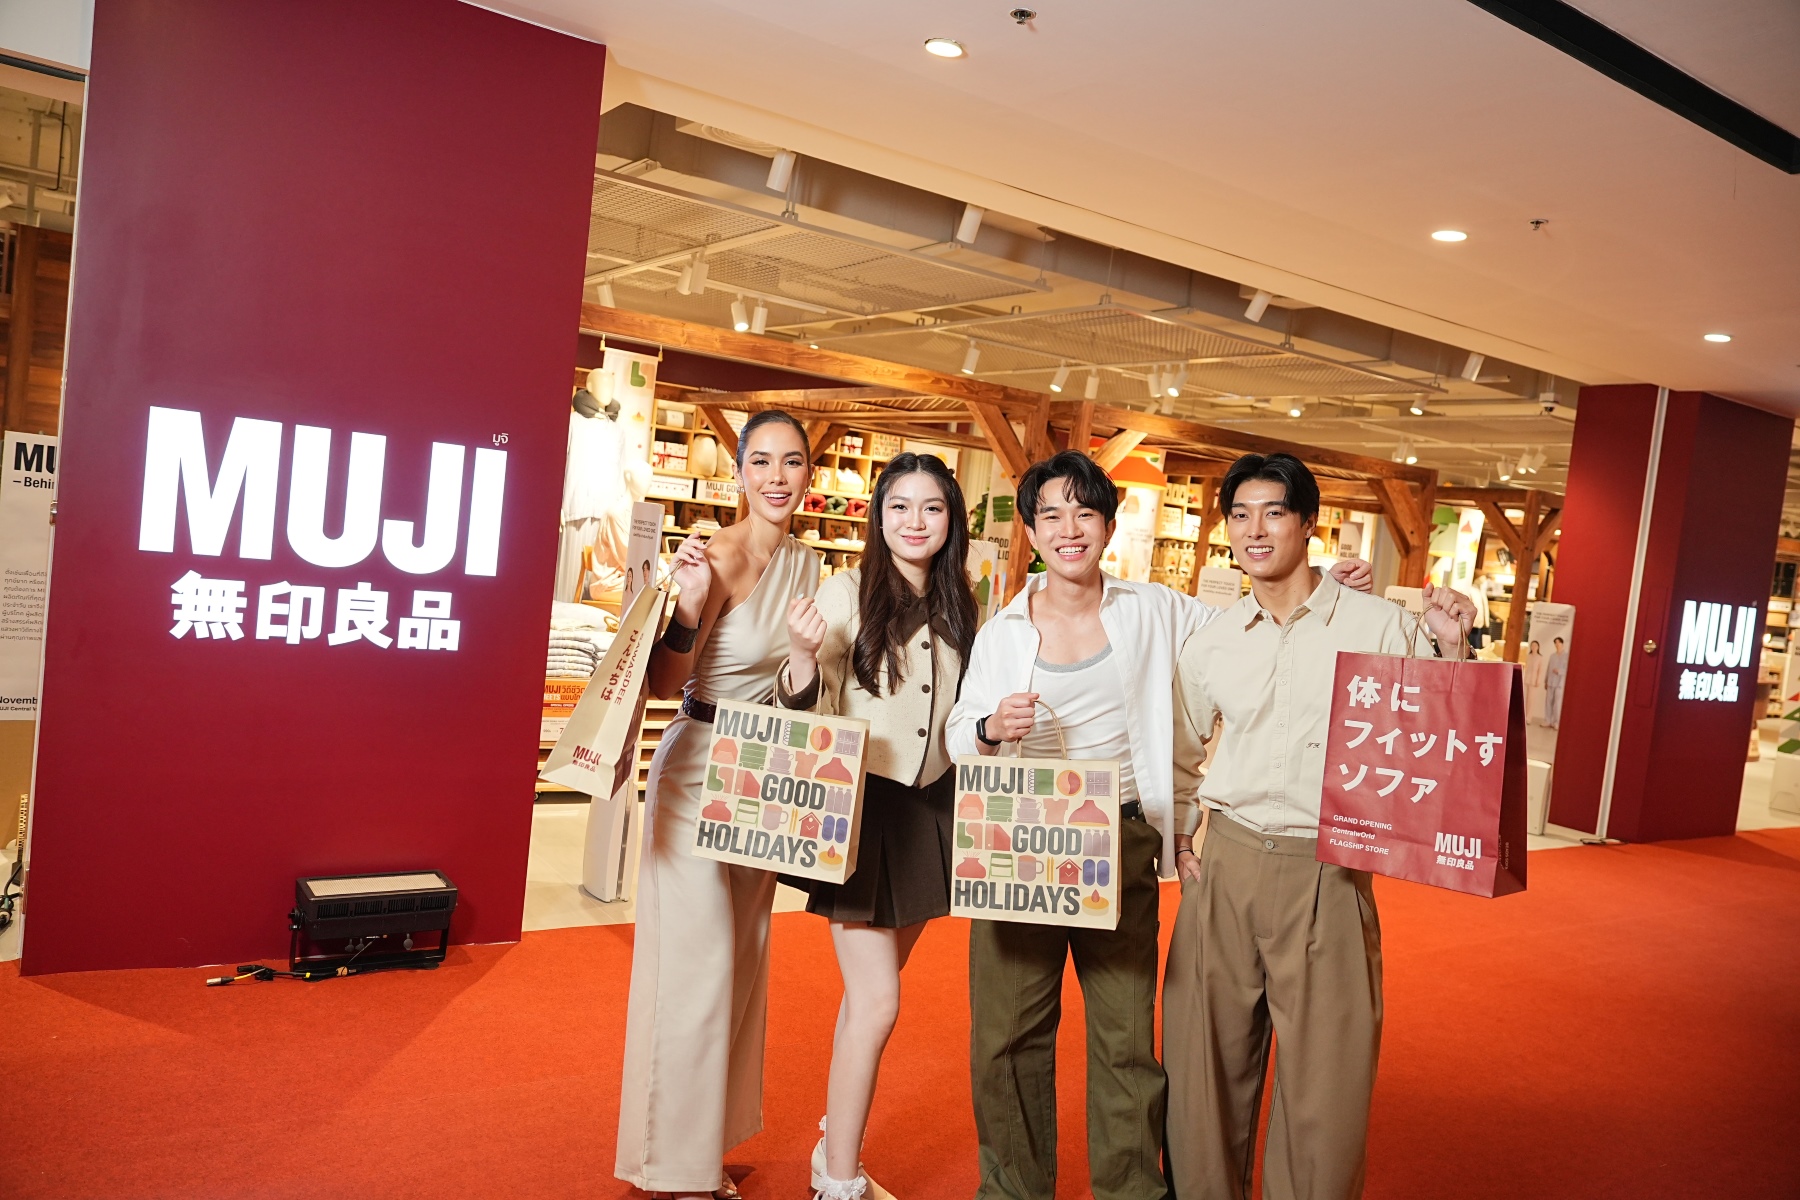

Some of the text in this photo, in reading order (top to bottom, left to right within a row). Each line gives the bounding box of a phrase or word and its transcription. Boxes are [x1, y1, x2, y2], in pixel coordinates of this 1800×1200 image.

[138, 405, 508, 577] MUJI
[706, 481, 724, 492] MUJI
[169, 569, 461, 651] 無印良品
[1387, 597, 1406, 607] OOD
[1676, 599, 1757, 668] MUJI
[600, 629, 639, 700] こんにちは
[1678, 668, 1739, 702] 無印良品
[716, 708, 782, 744] MUJI
[1344, 719, 1503, 767] フィットす
[573, 745, 602, 765] MUJI
[761, 773, 827, 810] GOOD
[959, 764, 1024, 795] MUJI
[1339, 763, 1438, 804] ソファ
[1012, 824, 1082, 856] GOOD
[1333, 814, 1392, 831] GRAND OPENING
[696, 820, 818, 868] HOLIDAYS
[1329, 838, 1390, 855] FLAGSHIP STORE
[1434, 831, 1482, 860] MUJI
[1436, 854, 1474, 871] 無印良品
[954, 879, 1080, 916] HOLIDAYS
